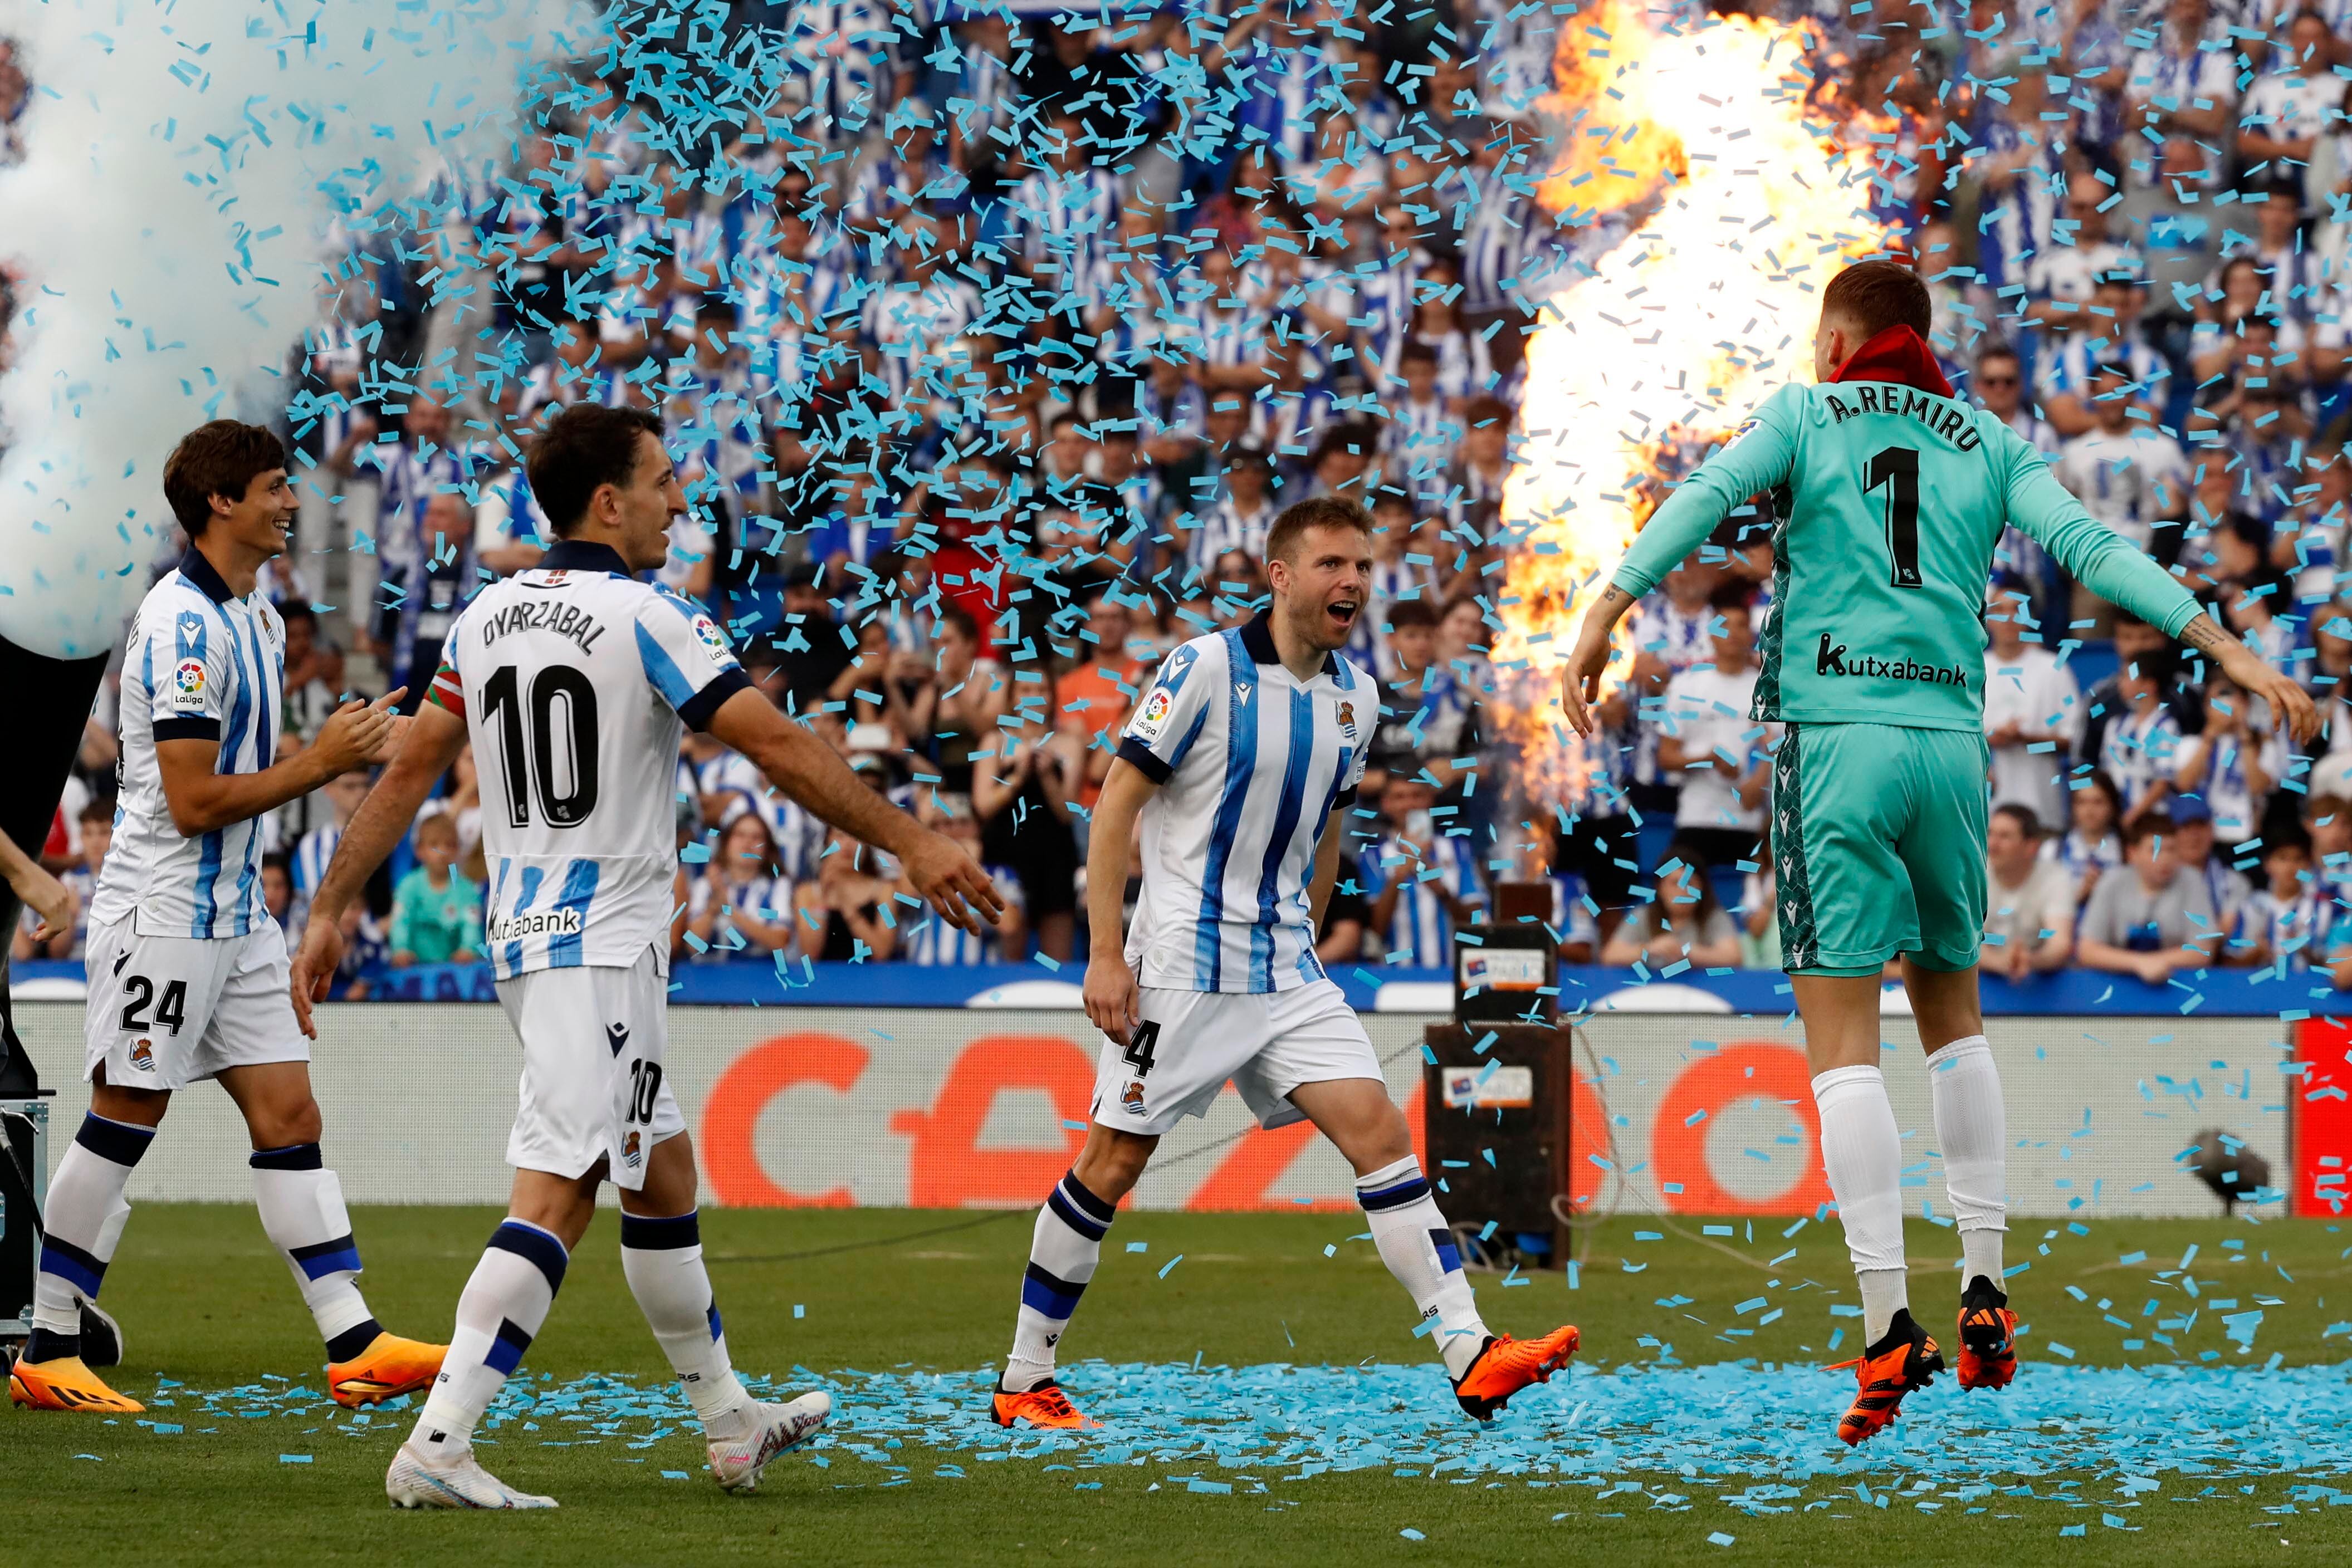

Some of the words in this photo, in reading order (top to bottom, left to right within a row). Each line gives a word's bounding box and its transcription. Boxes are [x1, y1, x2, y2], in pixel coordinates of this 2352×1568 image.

[1825, 386, 1980, 452] A.REMIRO
[1862, 446, 1924, 589] 1
[483, 601, 605, 657] OYARZABAL
[1816, 633, 1968, 687] Kutxabank
[175, 695, 203, 705] LaLiga
[1136, 719, 1157, 736] LaLiga
[478, 664, 599, 829] 10
[119, 975, 188, 1037] 24
[1121, 1019, 1161, 1079] 4
[625, 1058, 662, 1126] 10
